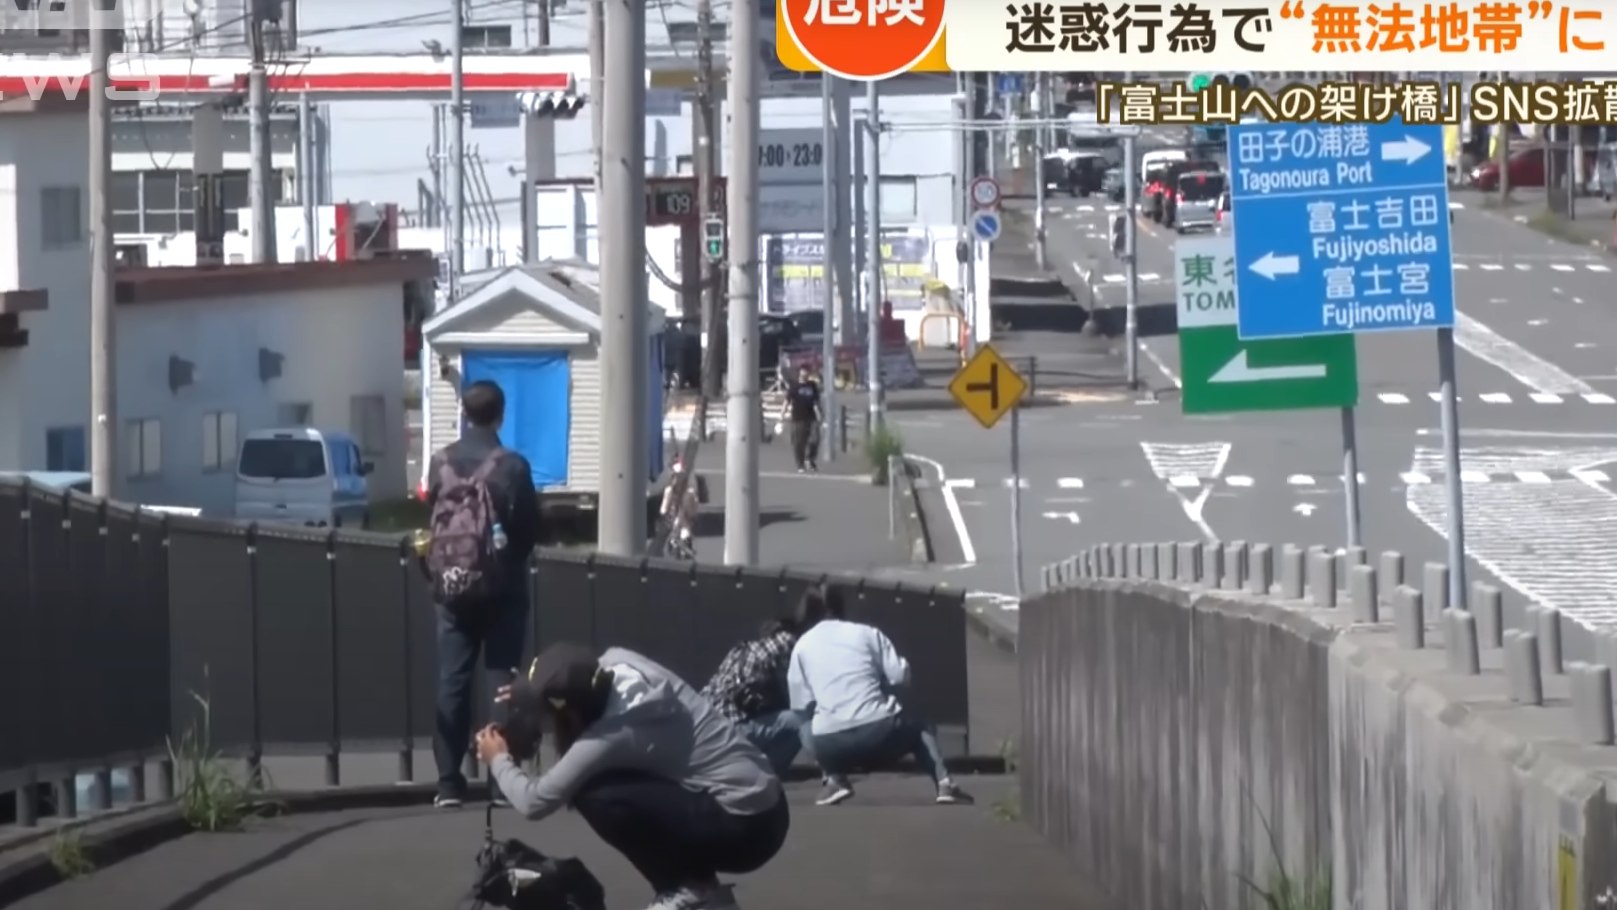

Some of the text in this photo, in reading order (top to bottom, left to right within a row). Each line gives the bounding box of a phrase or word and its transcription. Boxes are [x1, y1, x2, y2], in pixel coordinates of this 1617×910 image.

[1238, 126, 1371, 164] 田子の浦港
[1239, 161, 1373, 194] Tagonoura Port
[1307, 195, 1438, 234] 富士吉田
[1312, 231, 1438, 262] Fujiyoshida
[1323, 261, 1430, 299] 富士宮
[1322, 299, 1436, 328] Fujinomiya
